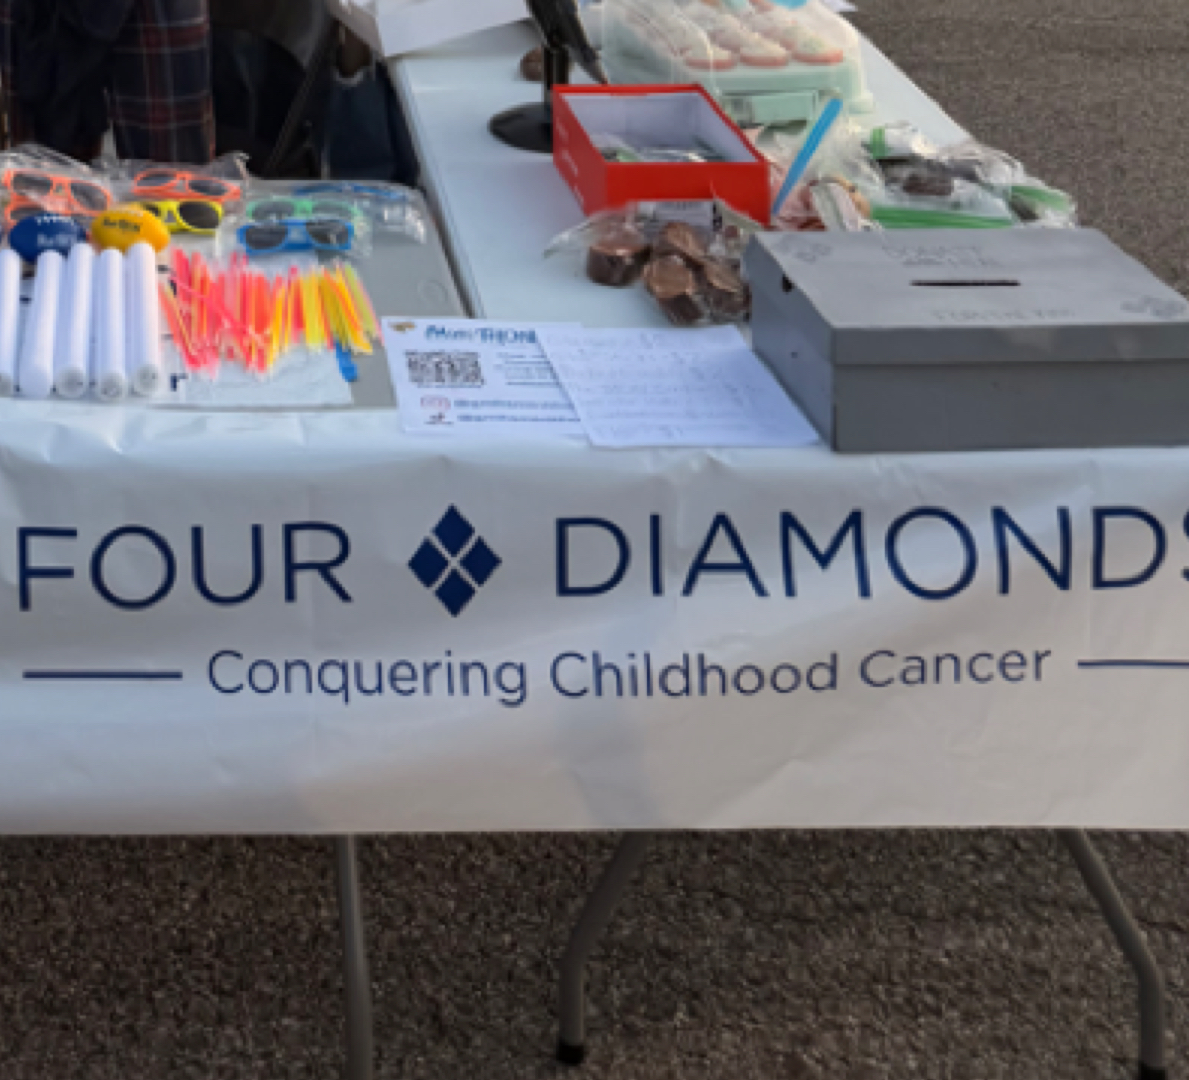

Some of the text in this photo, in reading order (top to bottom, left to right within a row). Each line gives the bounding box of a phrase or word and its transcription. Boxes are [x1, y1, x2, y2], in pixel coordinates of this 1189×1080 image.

[16, 505, 1189, 613] FOUR DIAMOND
[208, 649, 1052, 709] Conquering Childhood Cancer
